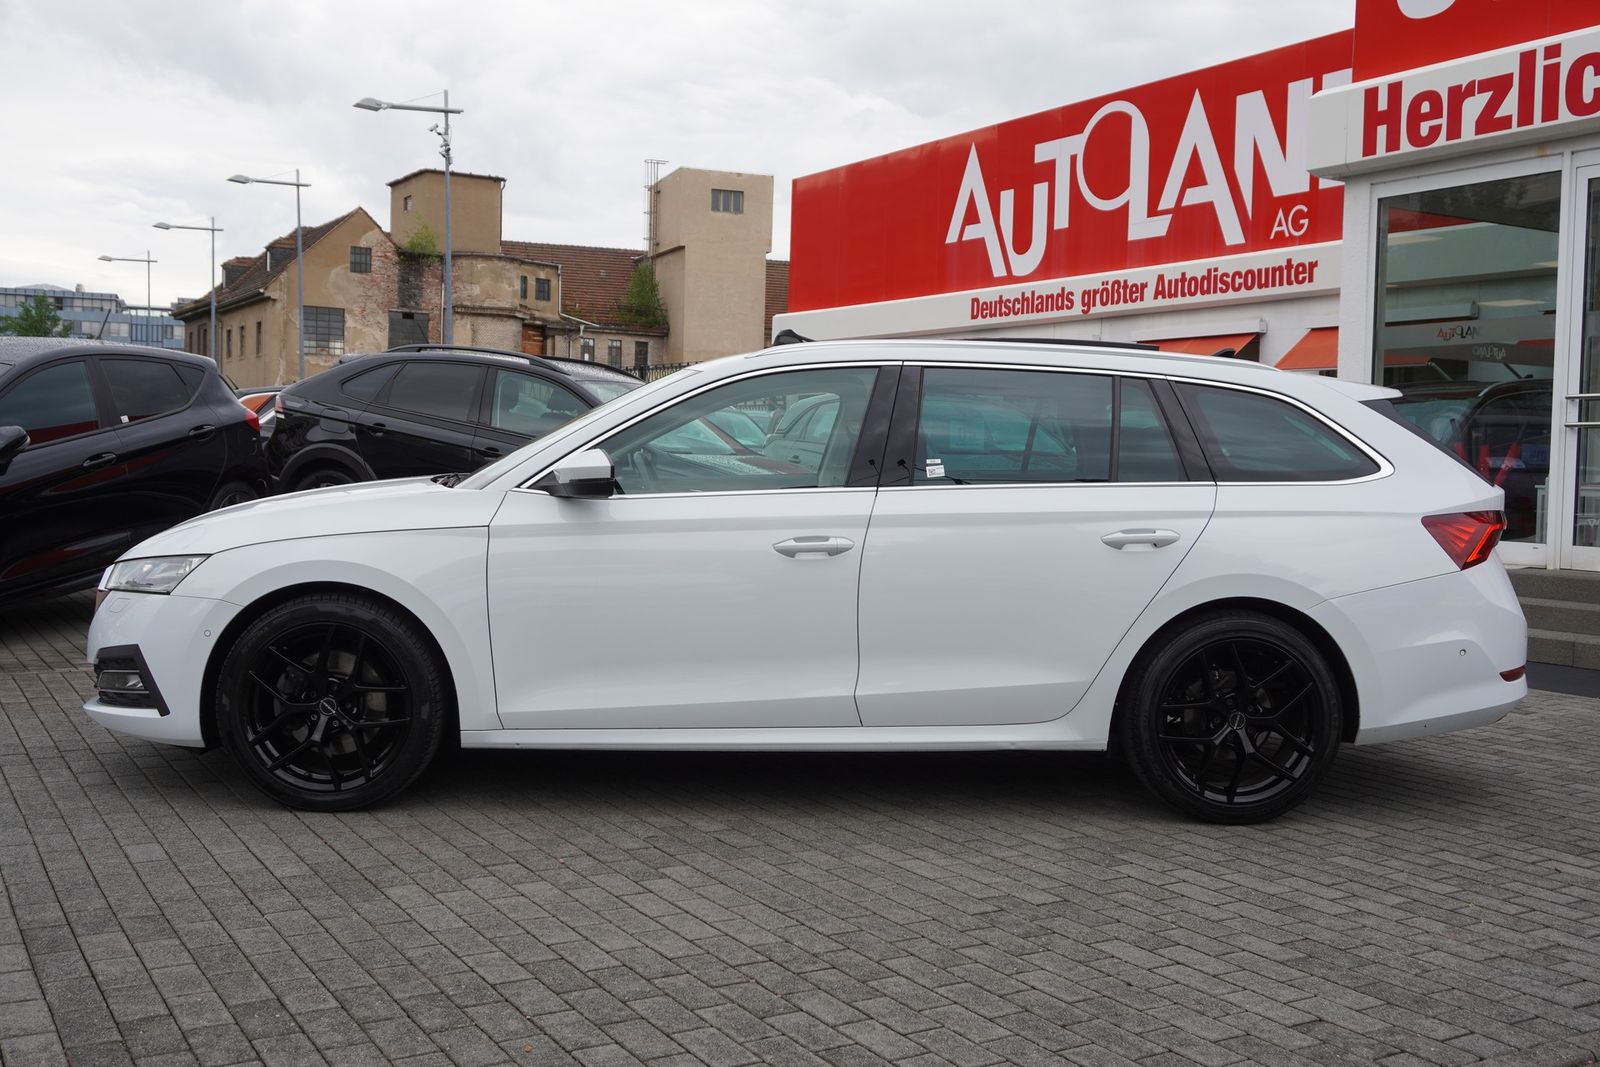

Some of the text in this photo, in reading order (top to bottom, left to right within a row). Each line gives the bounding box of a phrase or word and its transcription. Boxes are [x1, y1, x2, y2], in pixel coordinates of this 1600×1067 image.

[1362, 42, 1600, 157] Herzlic
[1270, 204, 1309, 240] AG
[970, 258, 1319, 320] Deutschlands größter Autodiscounter
